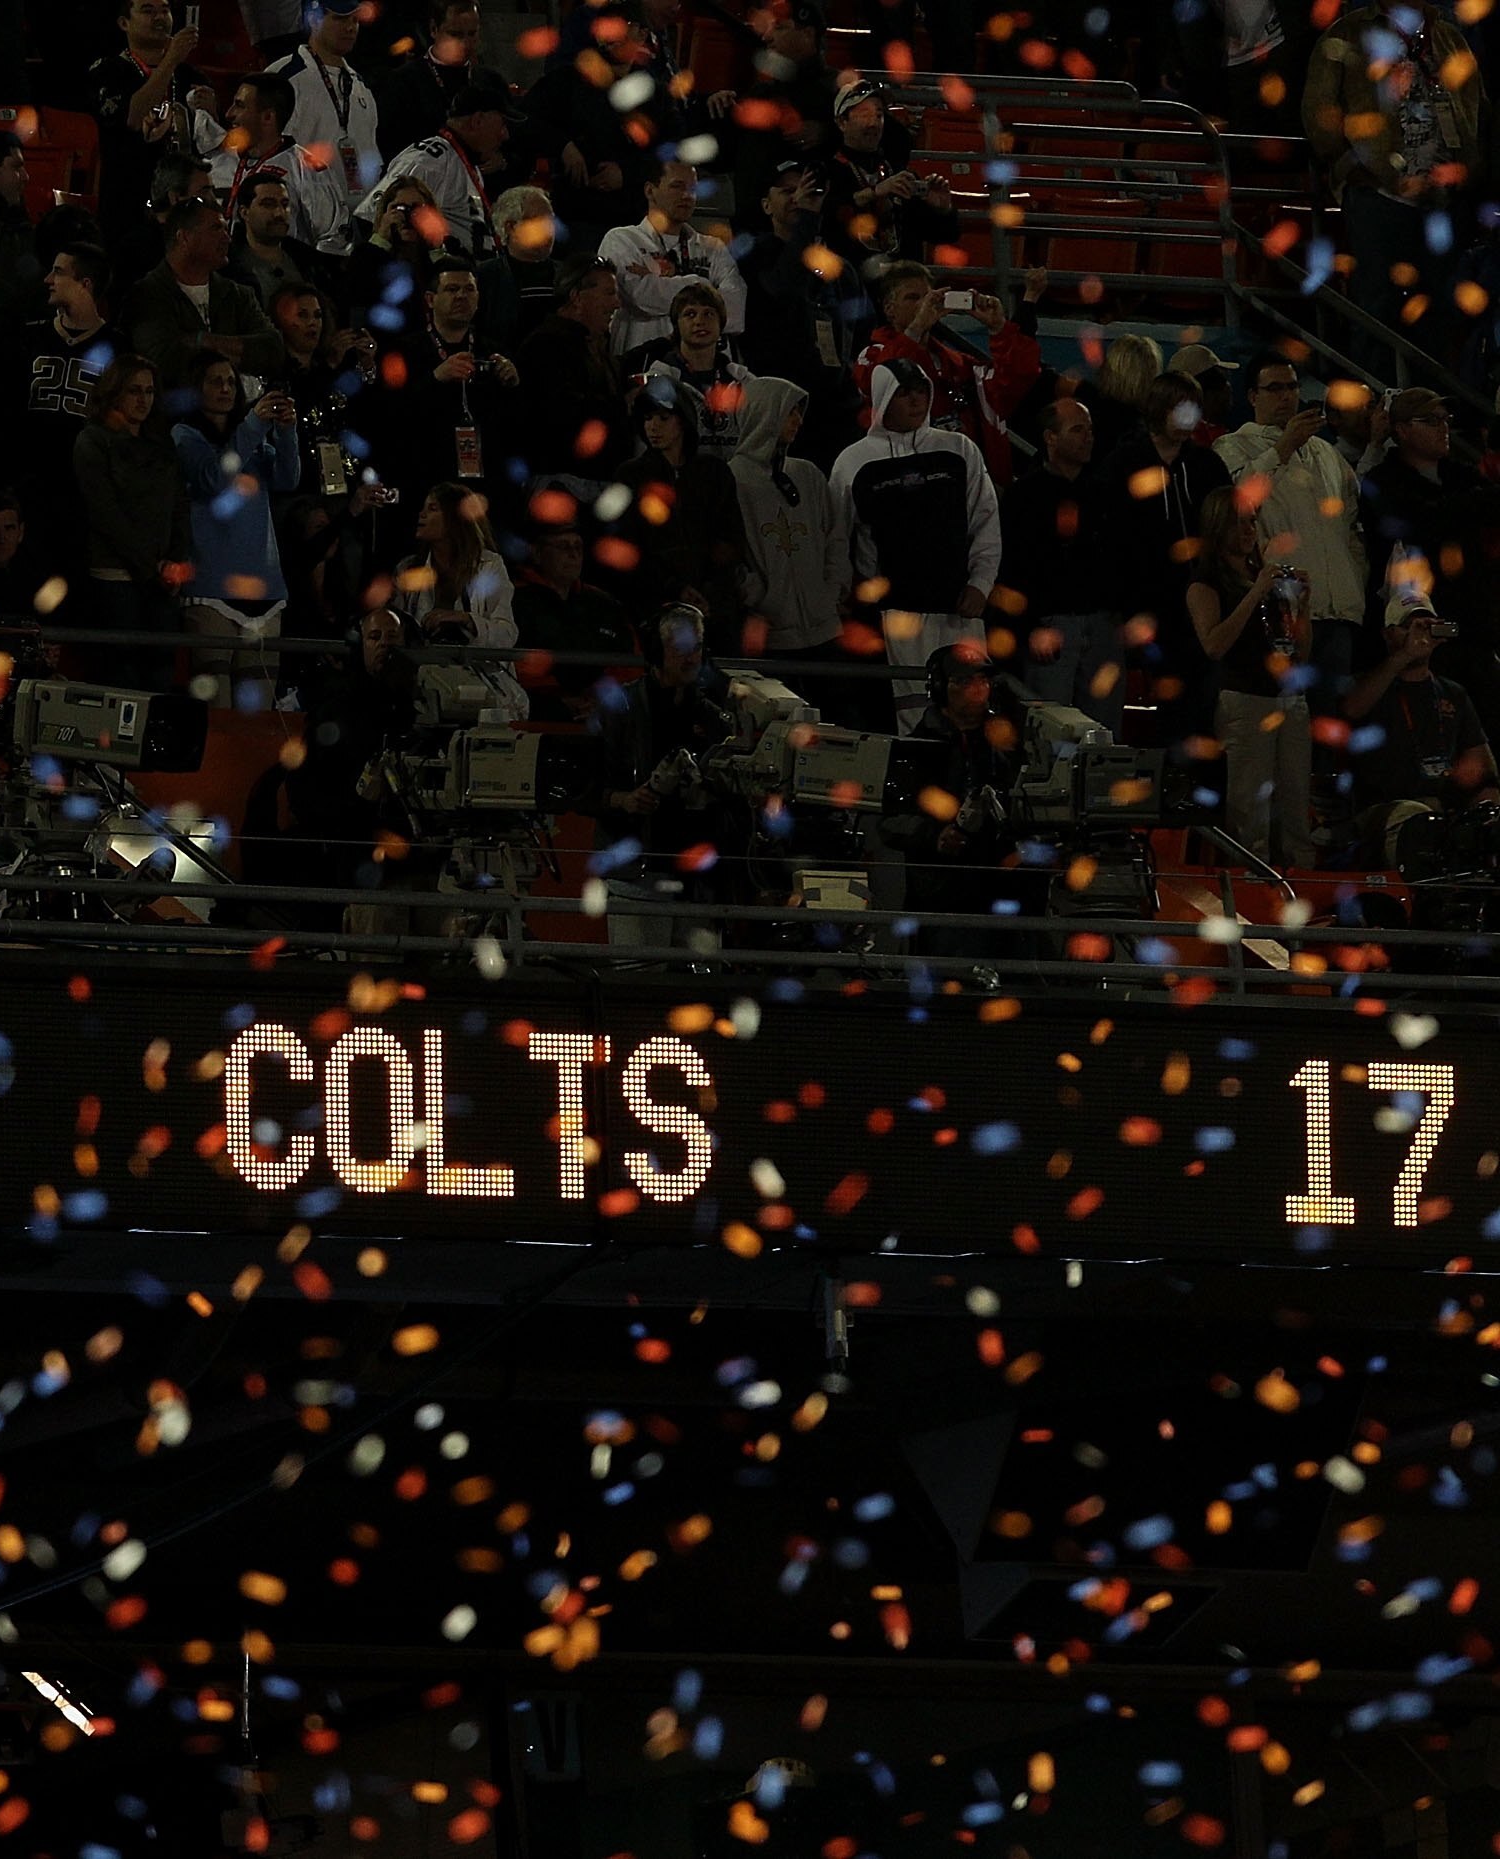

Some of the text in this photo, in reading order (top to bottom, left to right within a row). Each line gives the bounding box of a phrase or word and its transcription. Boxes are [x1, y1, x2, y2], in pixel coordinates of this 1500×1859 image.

[28, 355, 104, 418] 25
[57, 726, 77, 741] 101
[225, 1022, 714, 1203] COLTS
[1285, 1058, 1456, 1227] 17
